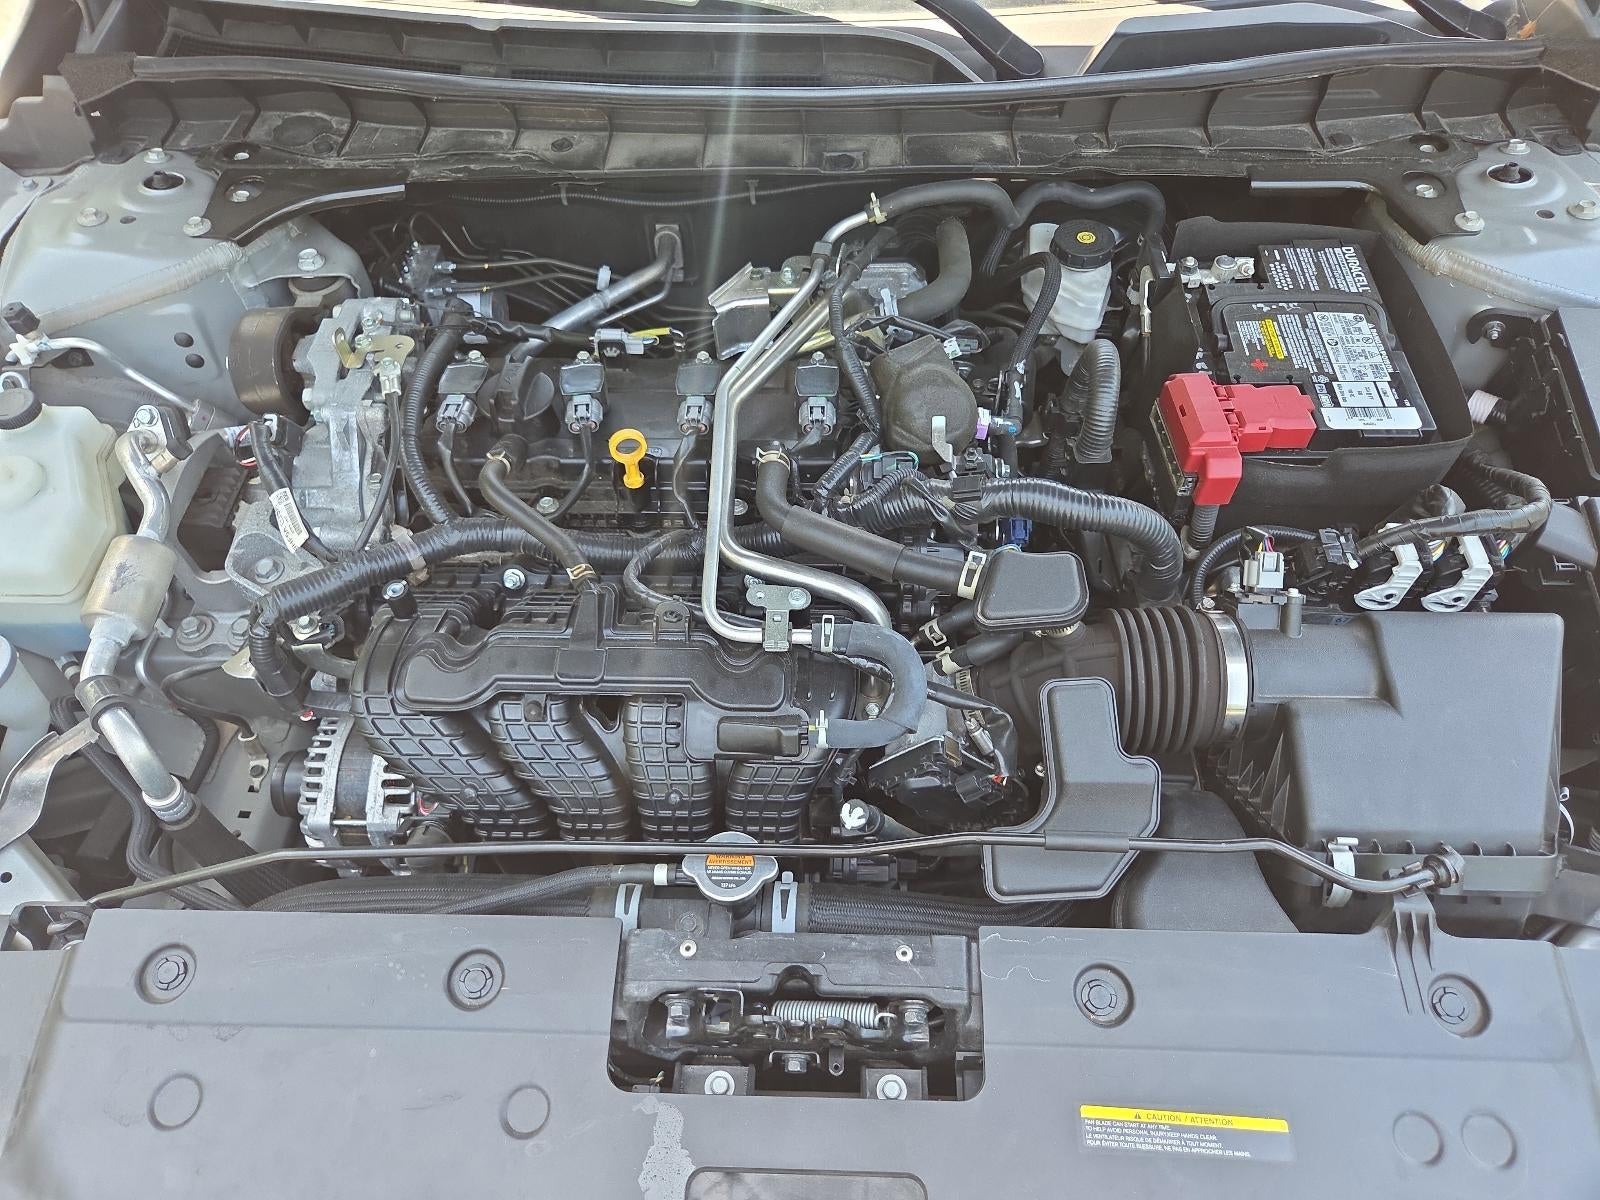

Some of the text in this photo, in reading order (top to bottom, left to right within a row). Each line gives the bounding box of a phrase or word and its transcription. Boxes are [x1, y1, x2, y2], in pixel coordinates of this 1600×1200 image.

[1342, 247, 1370, 292] DURACELL
[1146, 1113, 1181, 1121] CAUTION
[1190, 1116, 1232, 1125] ATTENTION
